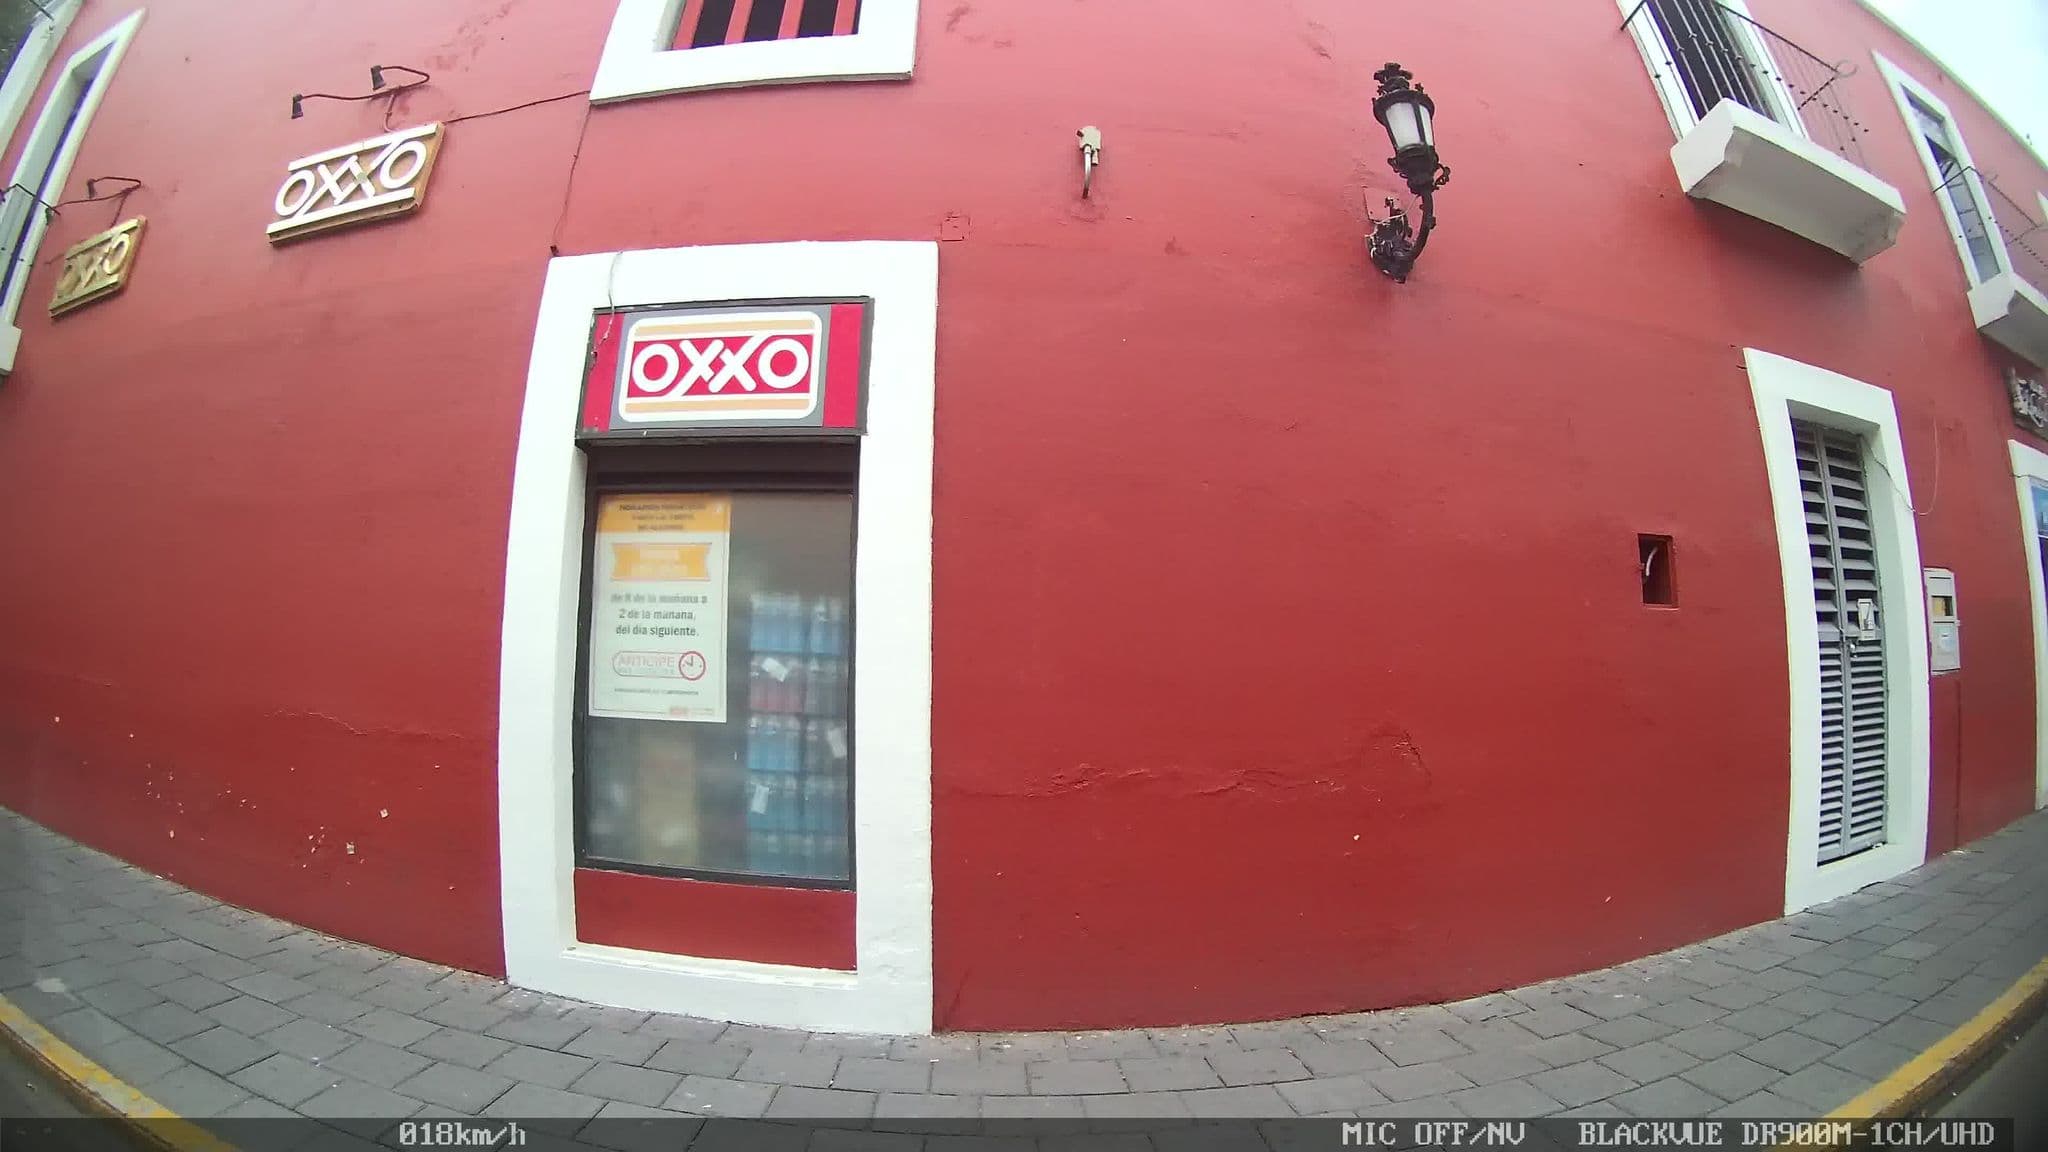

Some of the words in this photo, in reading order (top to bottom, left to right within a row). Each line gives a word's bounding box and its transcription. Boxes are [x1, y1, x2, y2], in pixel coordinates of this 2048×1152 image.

[274, 139, 427, 218] OXXO
[630, 334, 811, 398] OXXO
[619, 608, 626, 619] 2
[628, 608, 640, 620] de
[641, 609, 651, 620] la
[615, 625, 631, 636] del
[649, 626, 700, 638] siguiente.
[617, 655, 676, 668] ANTICIPE
